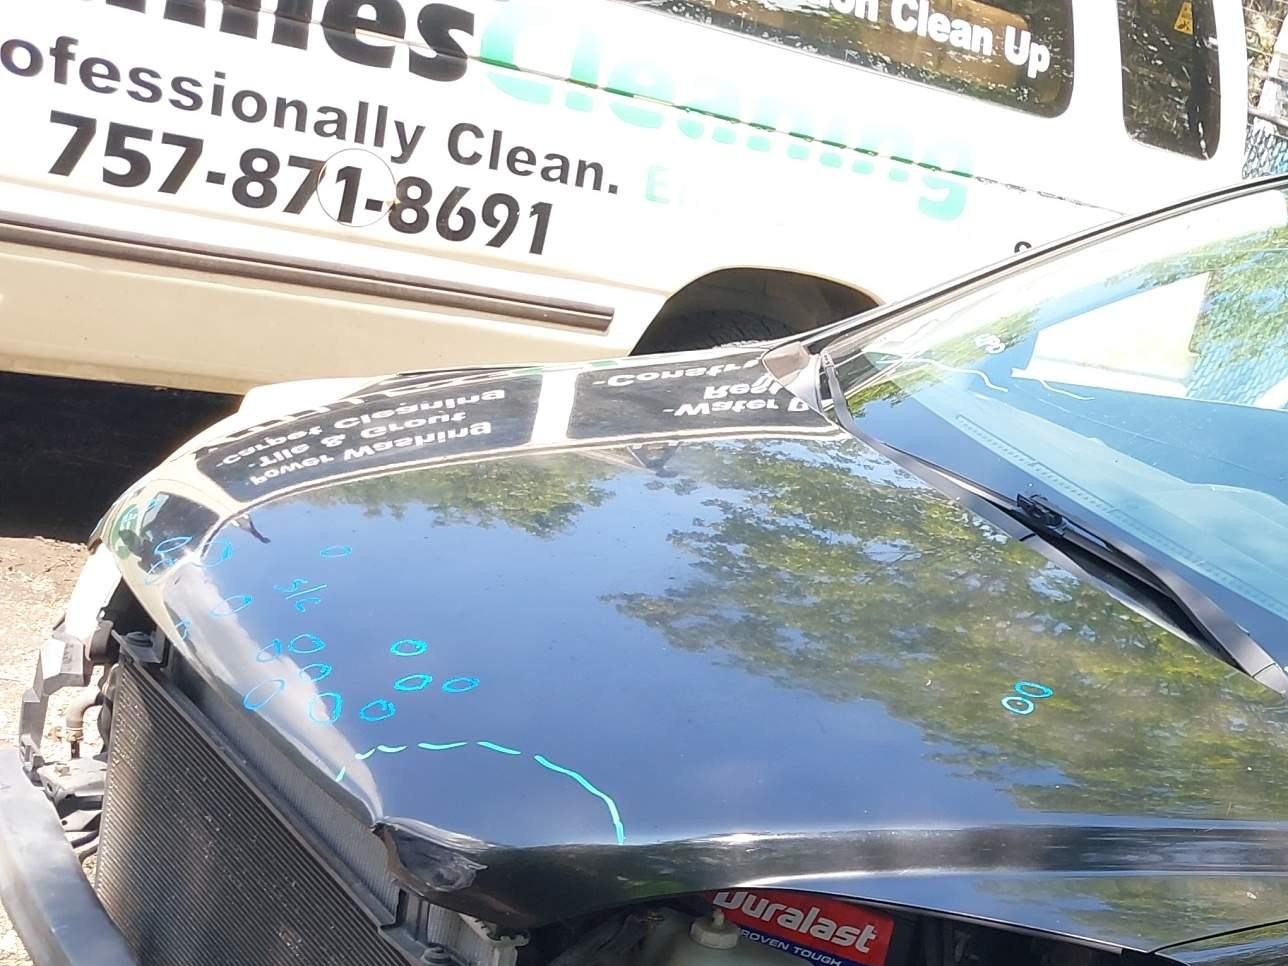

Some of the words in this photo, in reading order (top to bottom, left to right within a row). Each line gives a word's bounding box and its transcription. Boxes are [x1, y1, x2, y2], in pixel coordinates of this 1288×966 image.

[890, 0, 994, 56] Clean
[1003, 25, 1051, 78] Up
[0, 36, 426, 164] ofessionally
[447, 122, 619, 194] Clean.
[48, 110, 554, 256] 757-871-8691
[712, 890, 877, 954] Duralast
